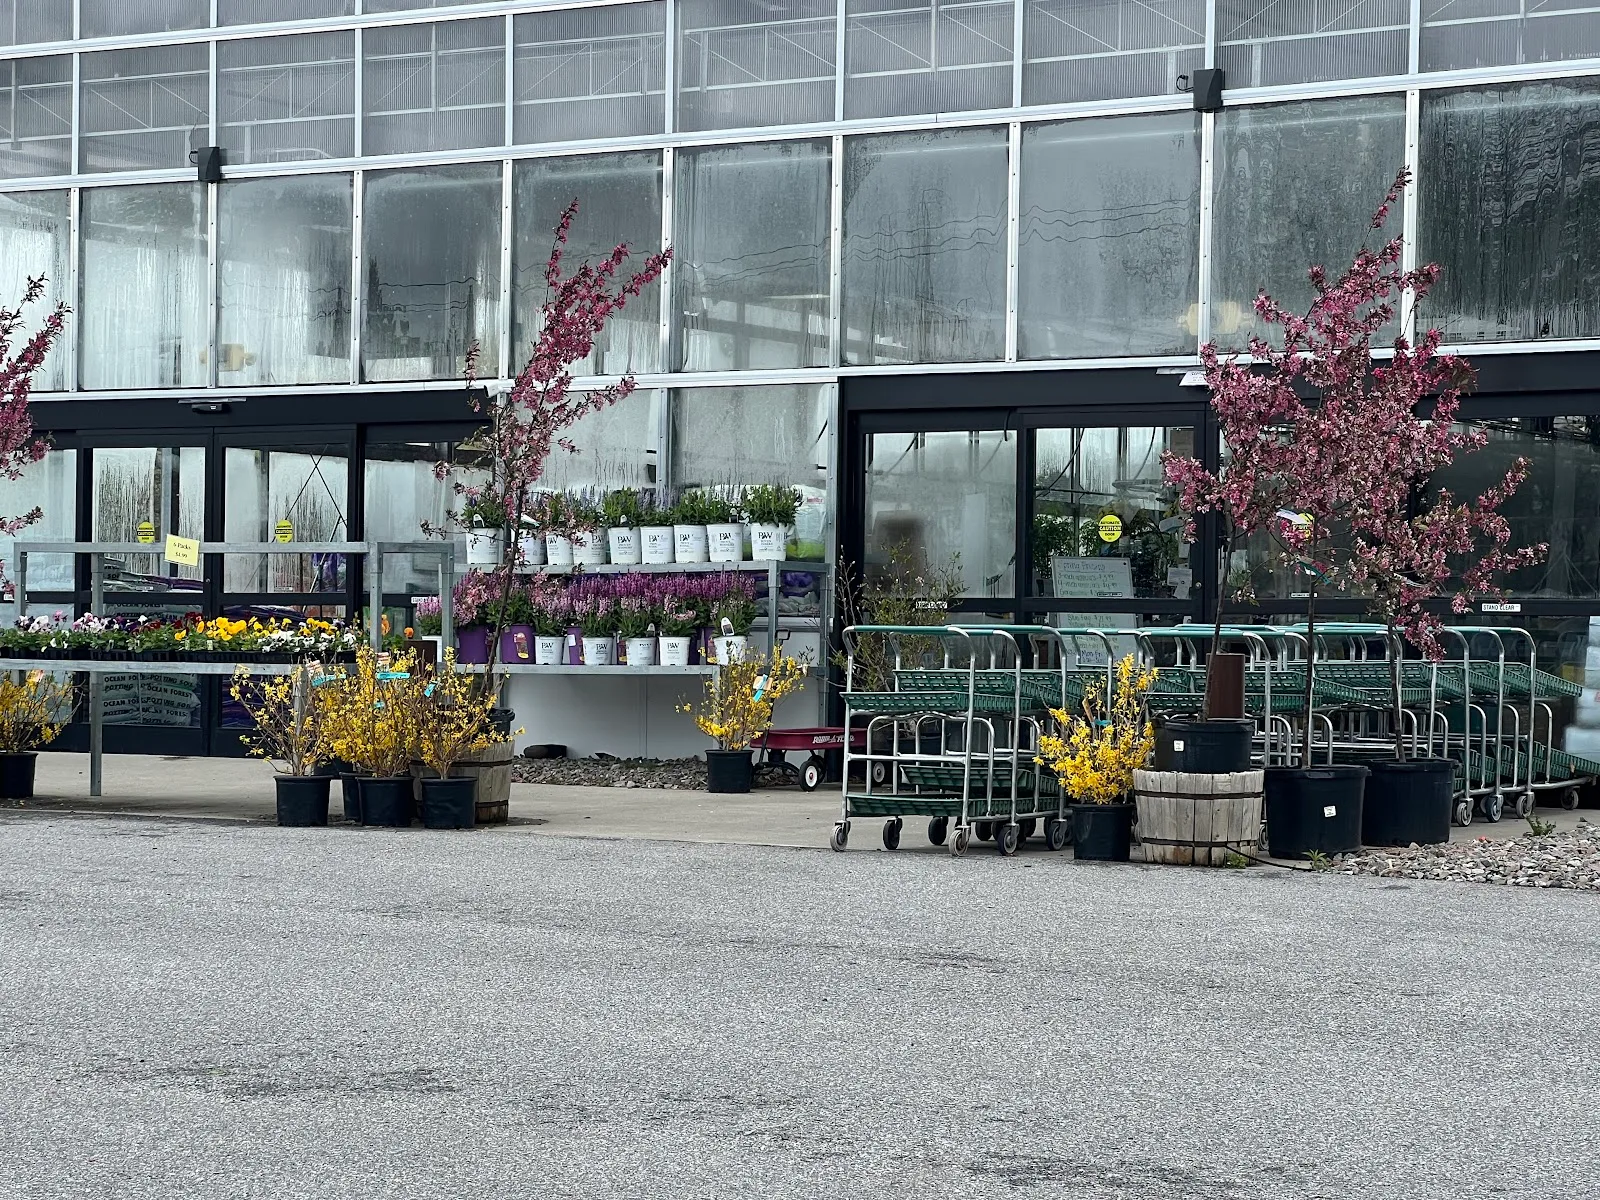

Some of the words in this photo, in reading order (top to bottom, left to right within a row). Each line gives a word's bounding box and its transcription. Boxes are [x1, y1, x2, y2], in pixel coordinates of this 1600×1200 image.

[104, 675, 126, 683] OCEAN
[104, 683, 134, 693] POTTING
[147, 686, 168, 694] OCEAN
[170, 688, 192, 699] FOREST
[103, 699, 126, 708] OCEAN
